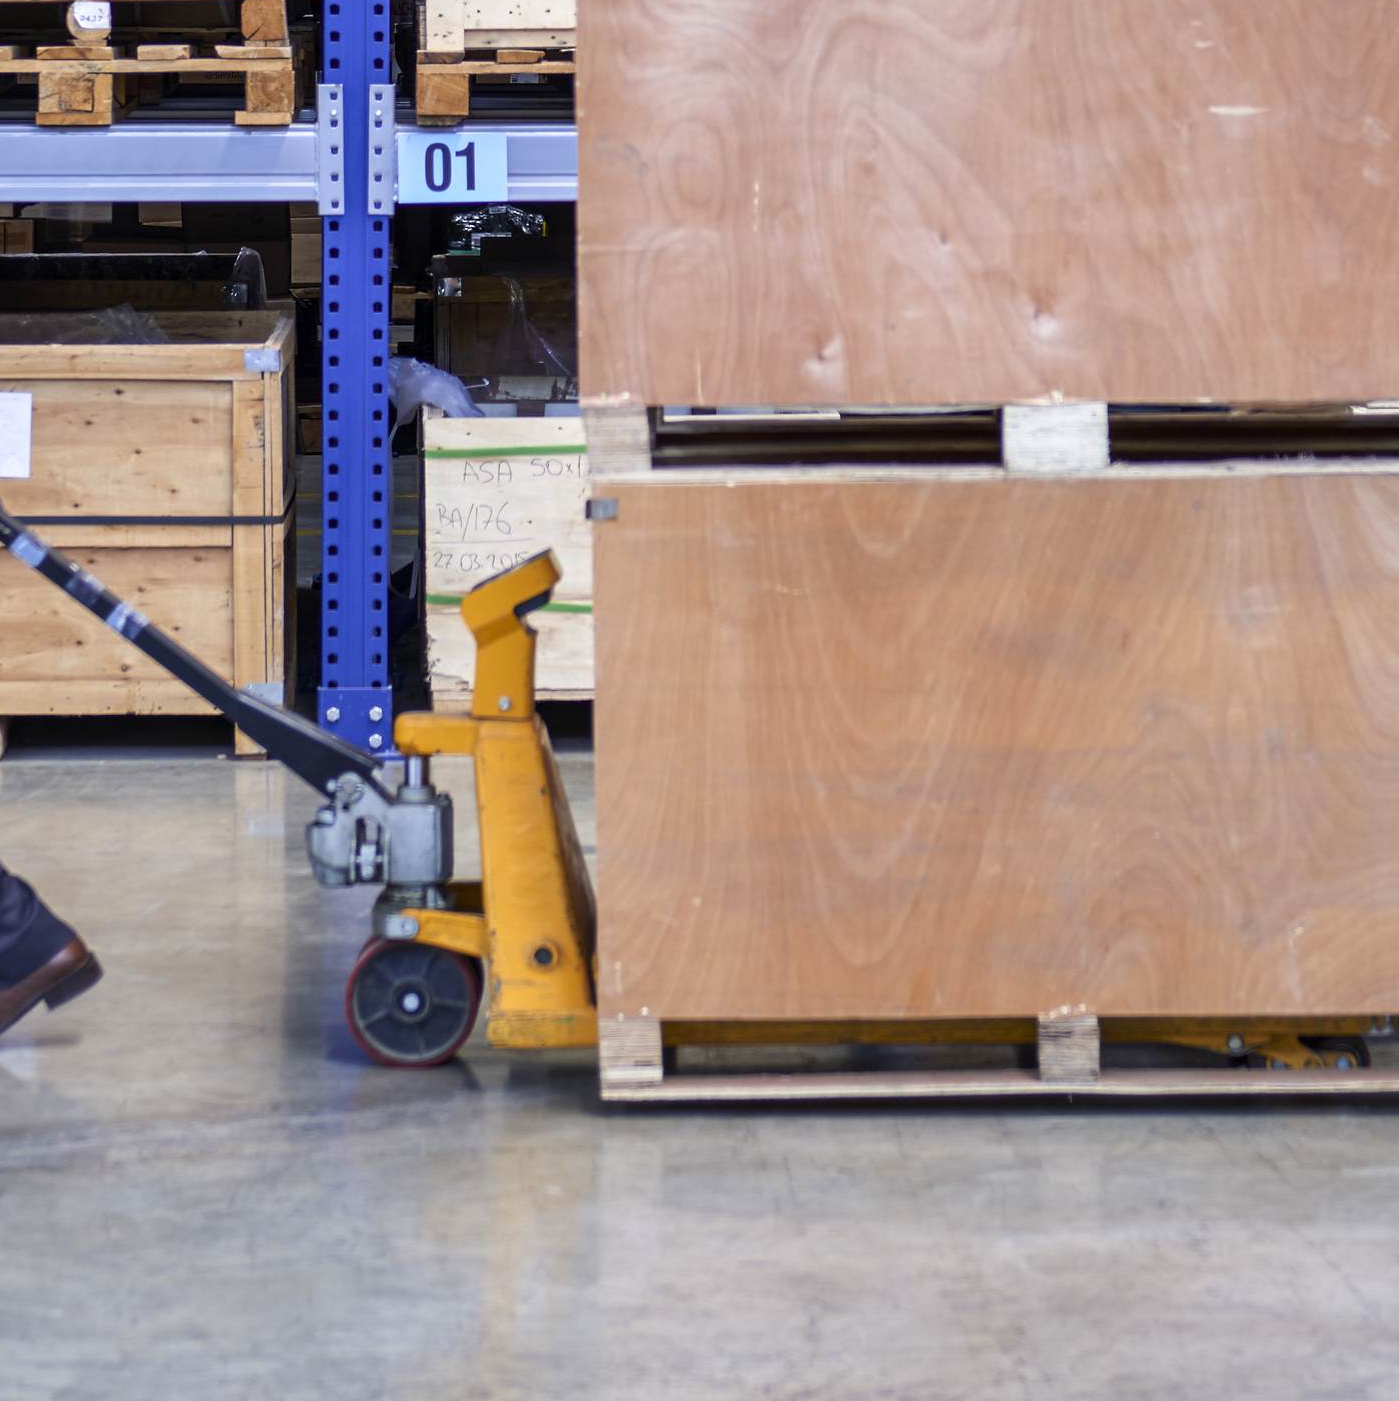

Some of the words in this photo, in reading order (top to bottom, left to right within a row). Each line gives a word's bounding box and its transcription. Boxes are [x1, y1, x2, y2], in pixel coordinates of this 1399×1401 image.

[424, 143, 477, 191] 01
[463, 460, 512, 483] ASA
[436, 502, 512, 541] BA/176
